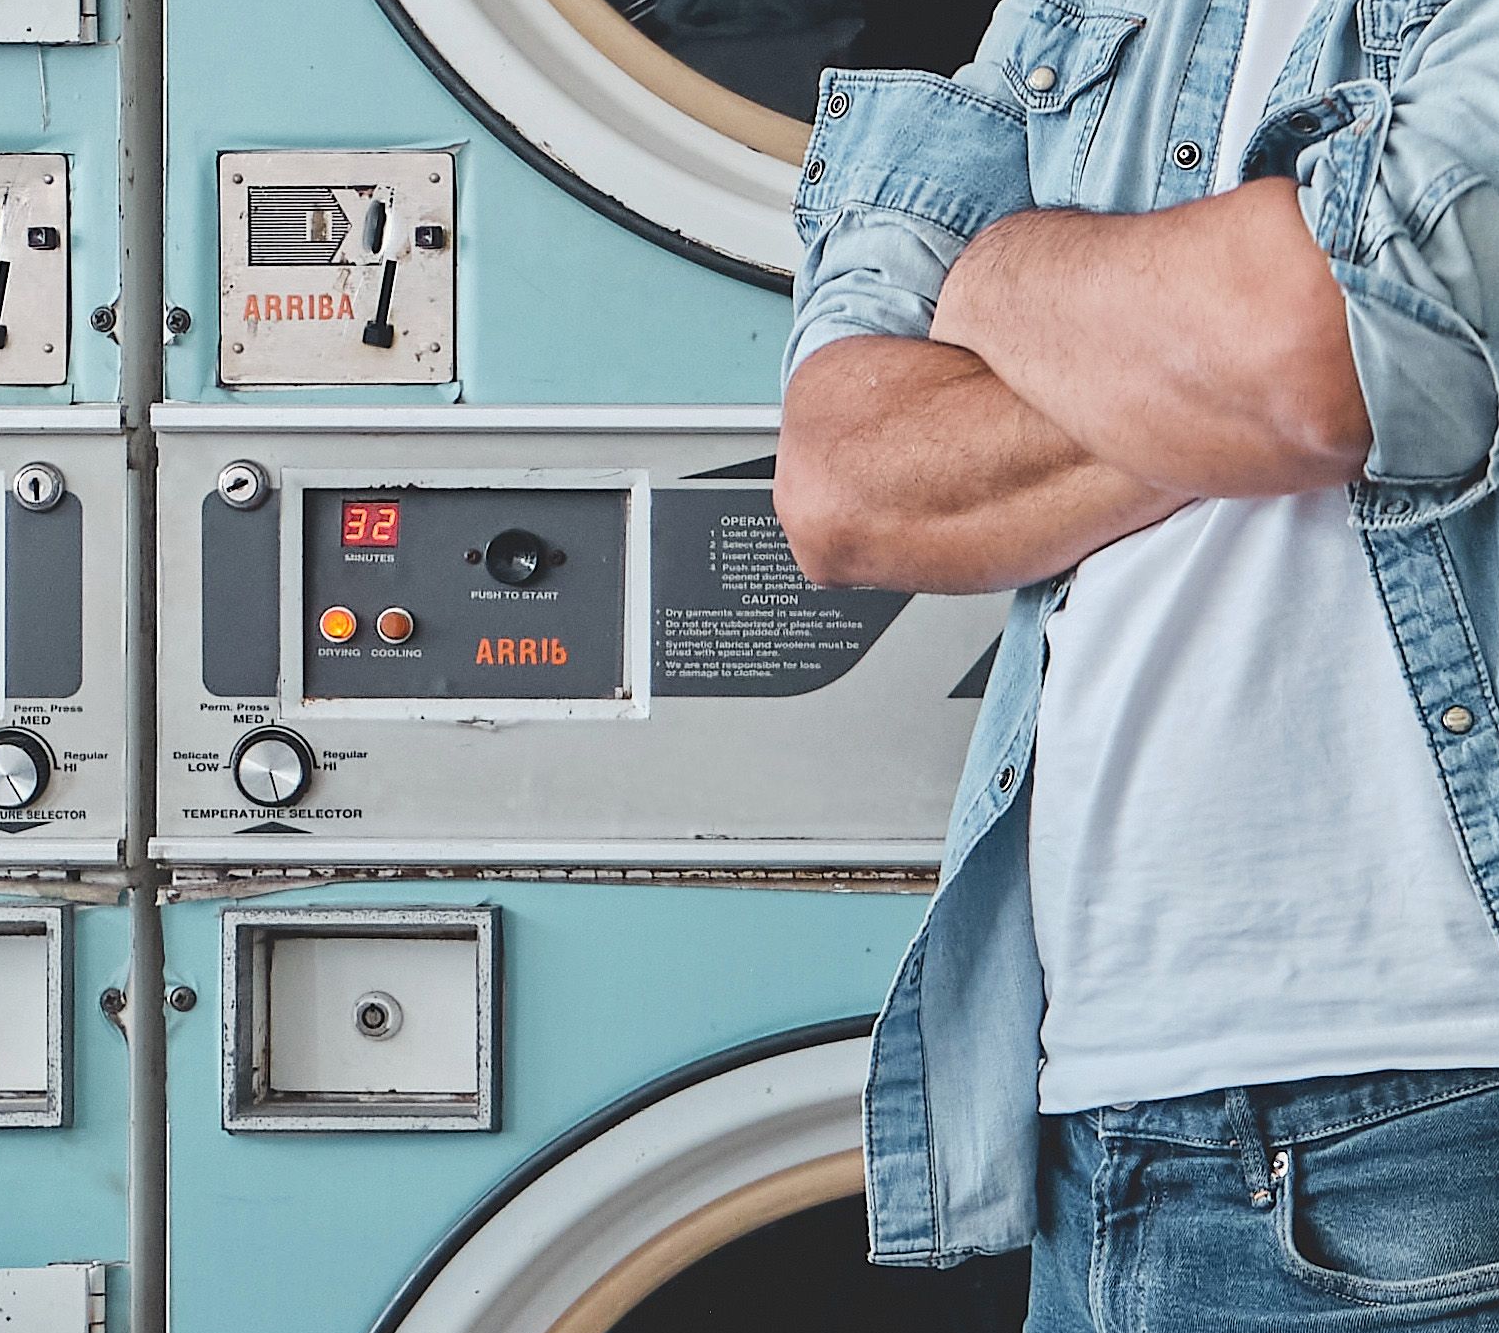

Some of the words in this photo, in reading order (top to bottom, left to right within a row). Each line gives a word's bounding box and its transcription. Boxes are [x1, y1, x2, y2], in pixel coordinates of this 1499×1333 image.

[244, 294, 354, 320] ARRIBA
[345, 506, 396, 541] 32
[721, 516, 781, 526] OPERATI
[722, 530, 747, 538] Load
[750, 530, 776, 539] dryer
[345, 555, 395, 563] MINUTES
[522, 592, 558, 600] START
[742, 595, 798, 604] CAUTION
[666, 609, 683, 617] Dry
[318, 649, 361, 657] DRYING
[371, 649, 422, 657] COOLING
[14, 705, 47, 713] Perm.
[51, 705, 83, 713] Press
[200, 704, 234, 712] Perm.
[238, 704, 269, 712] Press
[20, 715, 51, 725] MED
[233, 715, 264, 724] MED
[64, 752, 108, 761] Regular
[173, 751, 219, 759] Delicate
[324, 751, 368, 760] Regular
[64, 763, 77, 772] HI
[188, 763, 219, 772] LOW
[324, 762, 337, 771] HI
[27, 810, 86, 820] SELECTOR
[183, 809, 285, 819] TEMPERATURE
[290, 809, 362, 819] SELECTOR
